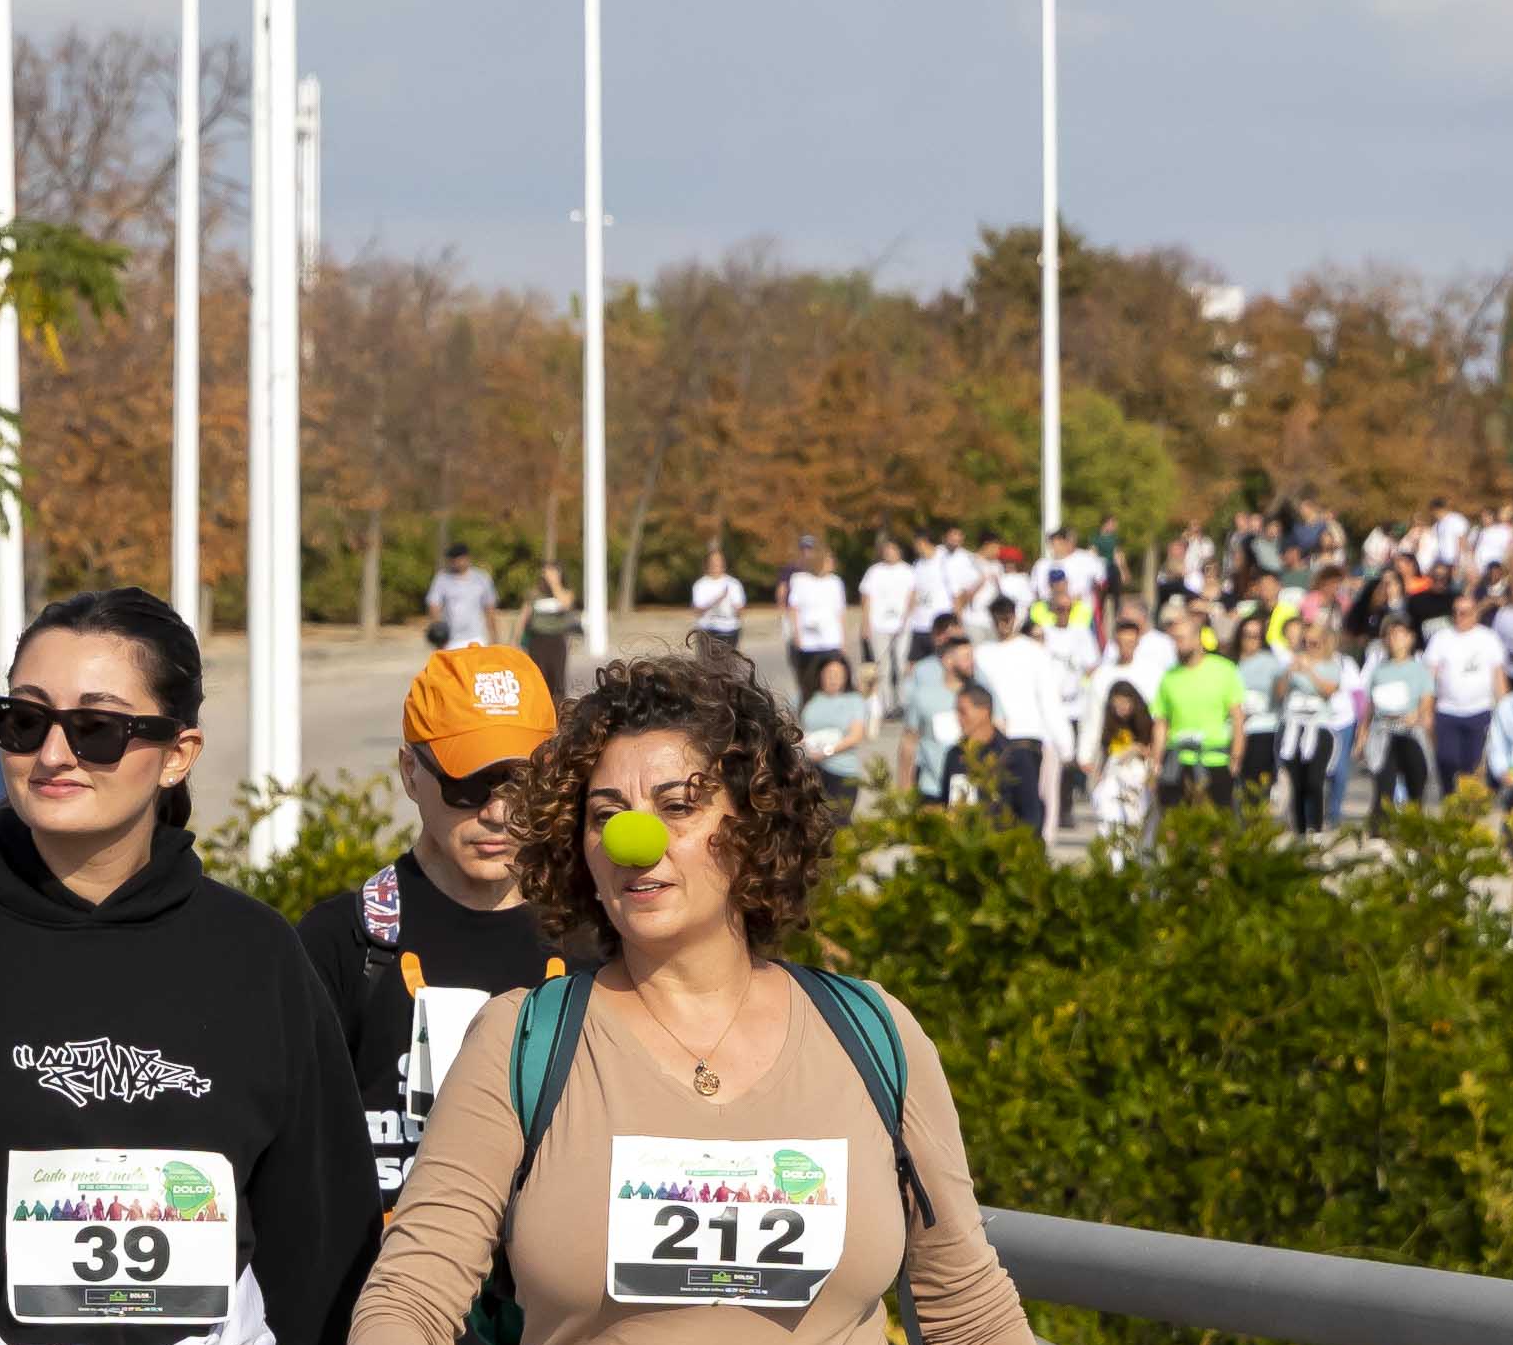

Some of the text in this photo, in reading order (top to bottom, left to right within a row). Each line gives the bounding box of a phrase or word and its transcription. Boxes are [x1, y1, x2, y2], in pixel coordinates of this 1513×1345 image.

[173, 1185, 212, 1194] DOLOR
[72, 1225, 170, 1282] 39
[652, 1205, 805, 1265] 212
